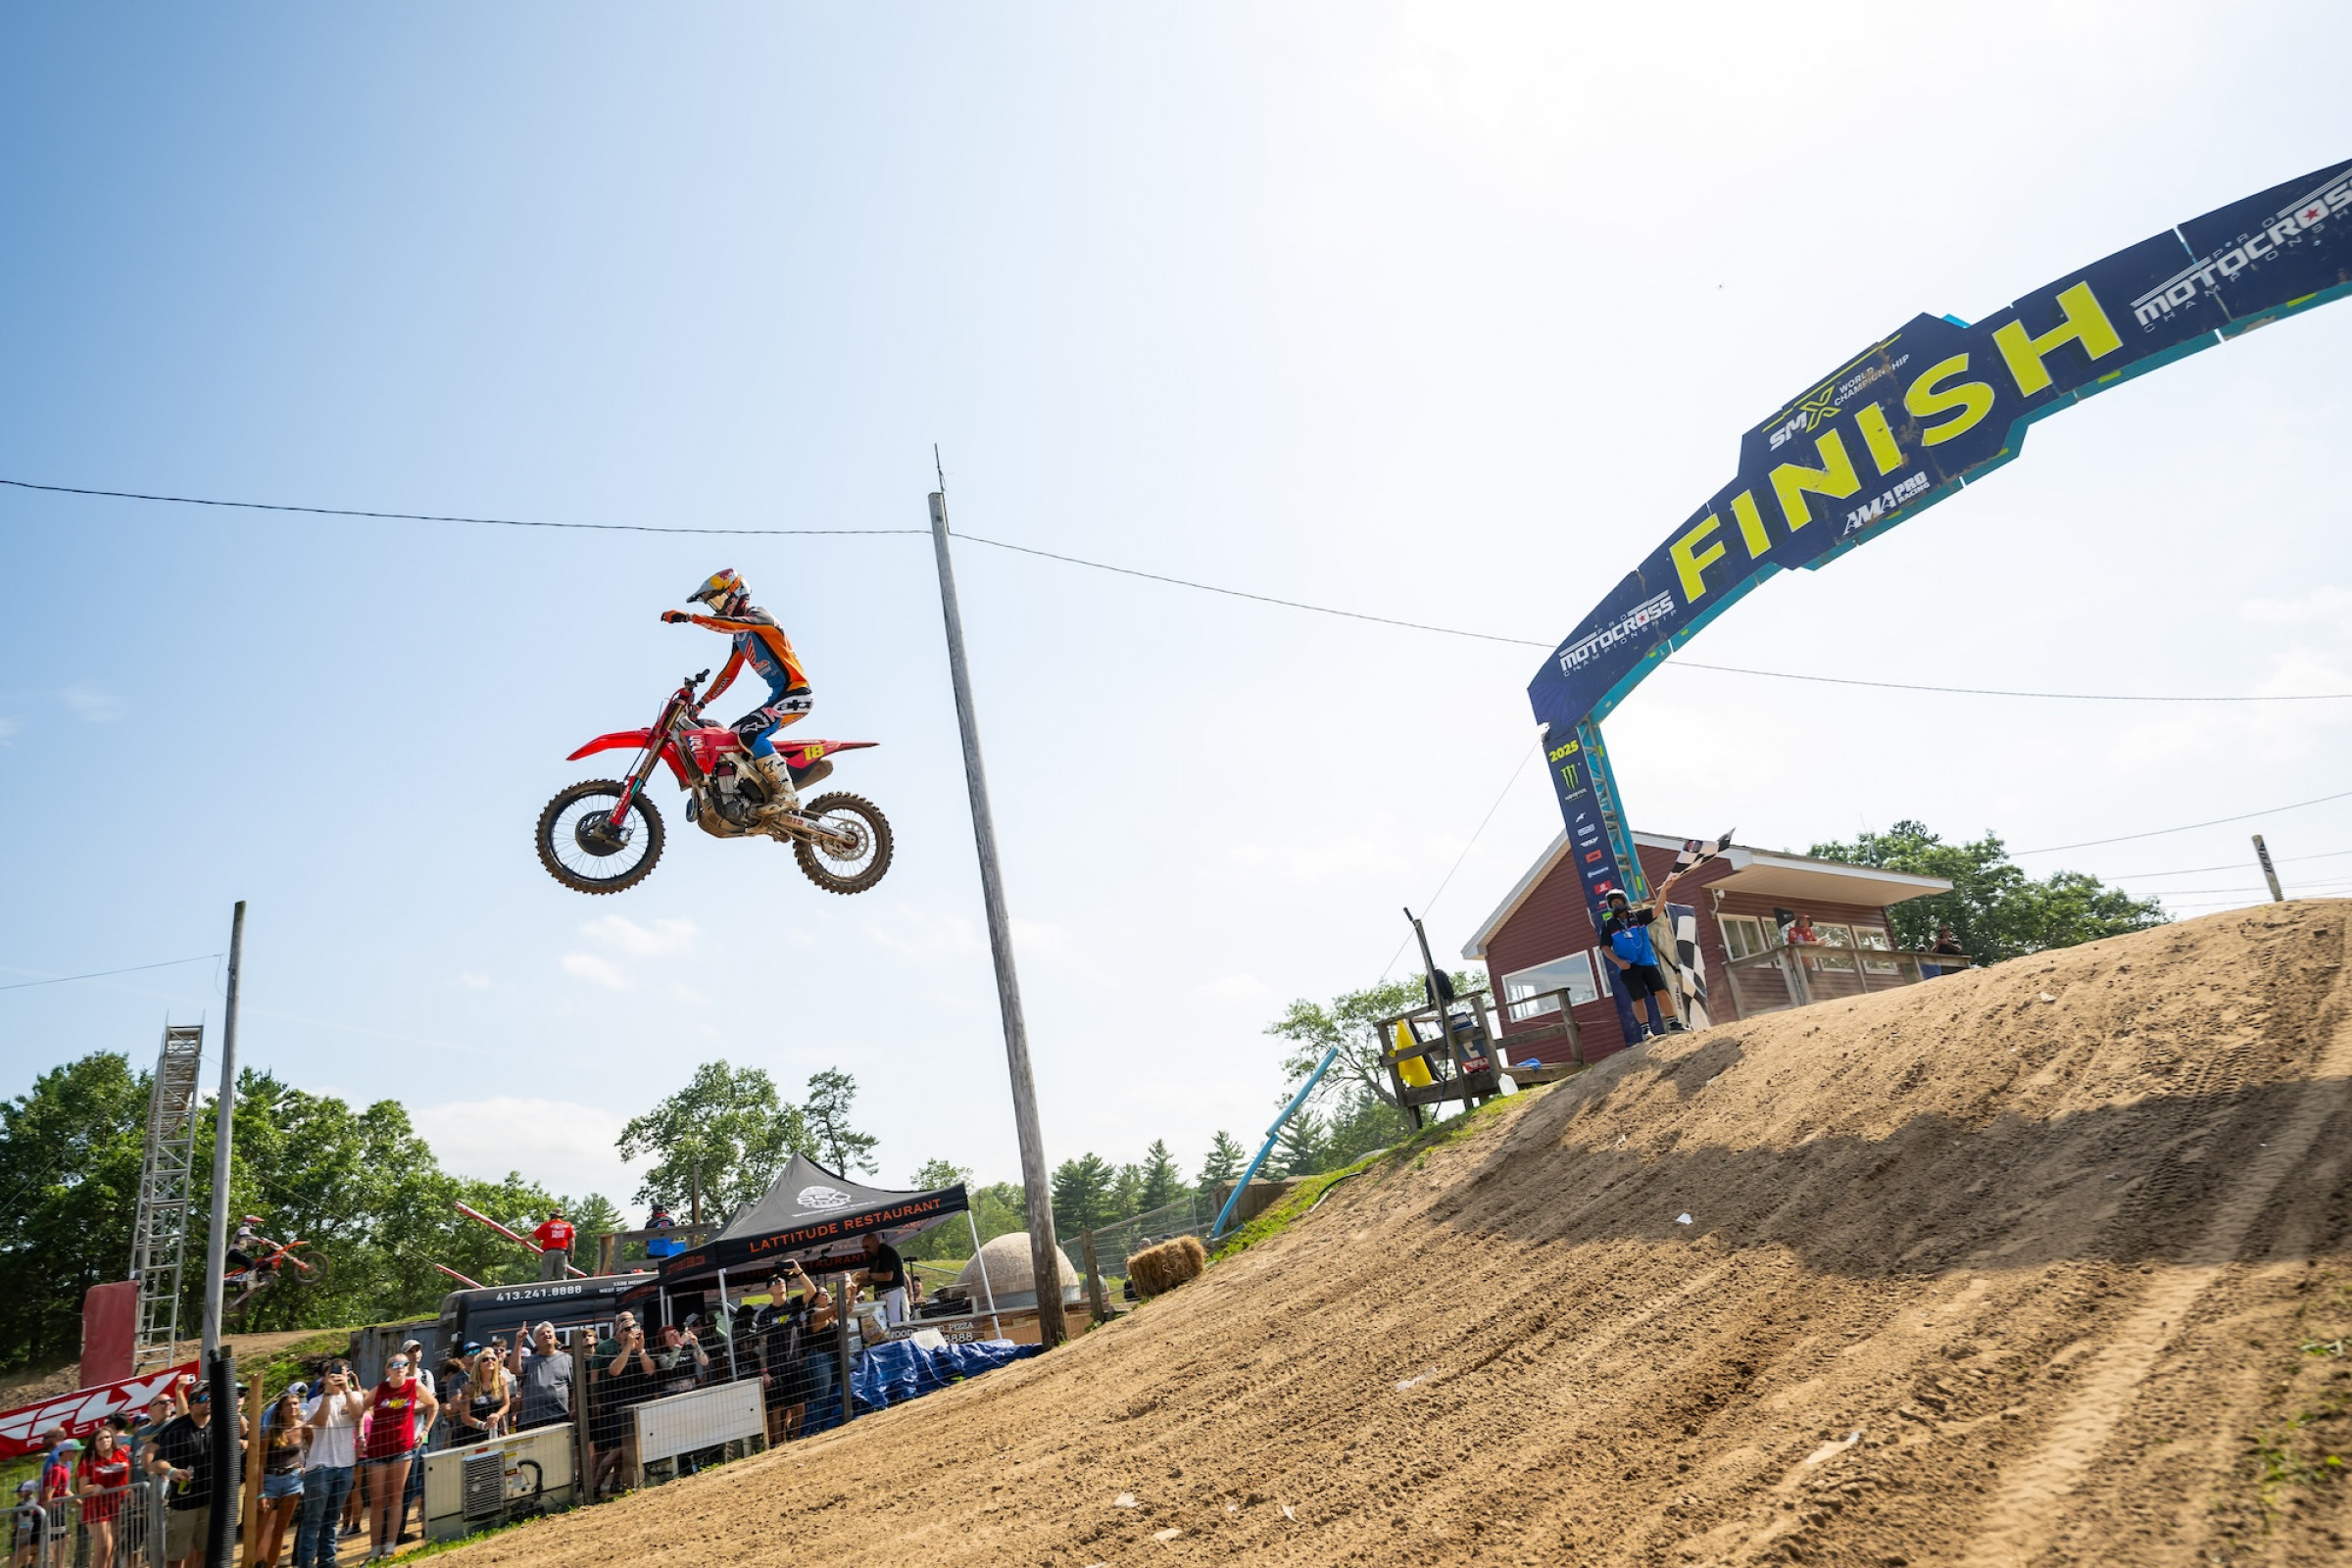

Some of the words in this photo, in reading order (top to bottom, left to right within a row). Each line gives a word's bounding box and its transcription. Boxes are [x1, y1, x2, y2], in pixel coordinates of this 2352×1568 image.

[2133, 178, 2352, 326] MOTOCROS
[1834, 353, 1910, 406] CHAMPIONSHIP
[1839, 367, 1874, 393] WORLD
[1669, 280, 2124, 604] FINISH
[1770, 385, 1841, 451] SMX
[1842, 490, 1897, 536] AMA
[1893, 470, 1928, 498] PRO
[1559, 595, 1675, 672] MOTOCROSS
[804, 745, 825, 760] 18
[1548, 739, 1579, 763] 2025
[750, 1222, 838, 1253] LATTITUDE
[844, 1198, 942, 1231] RESTAURANT
[496, 1285, 582, 1301] 413.241.8888
[949, 1322, 974, 1332] PIZZA
[0, 1370, 182, 1441] FLY
